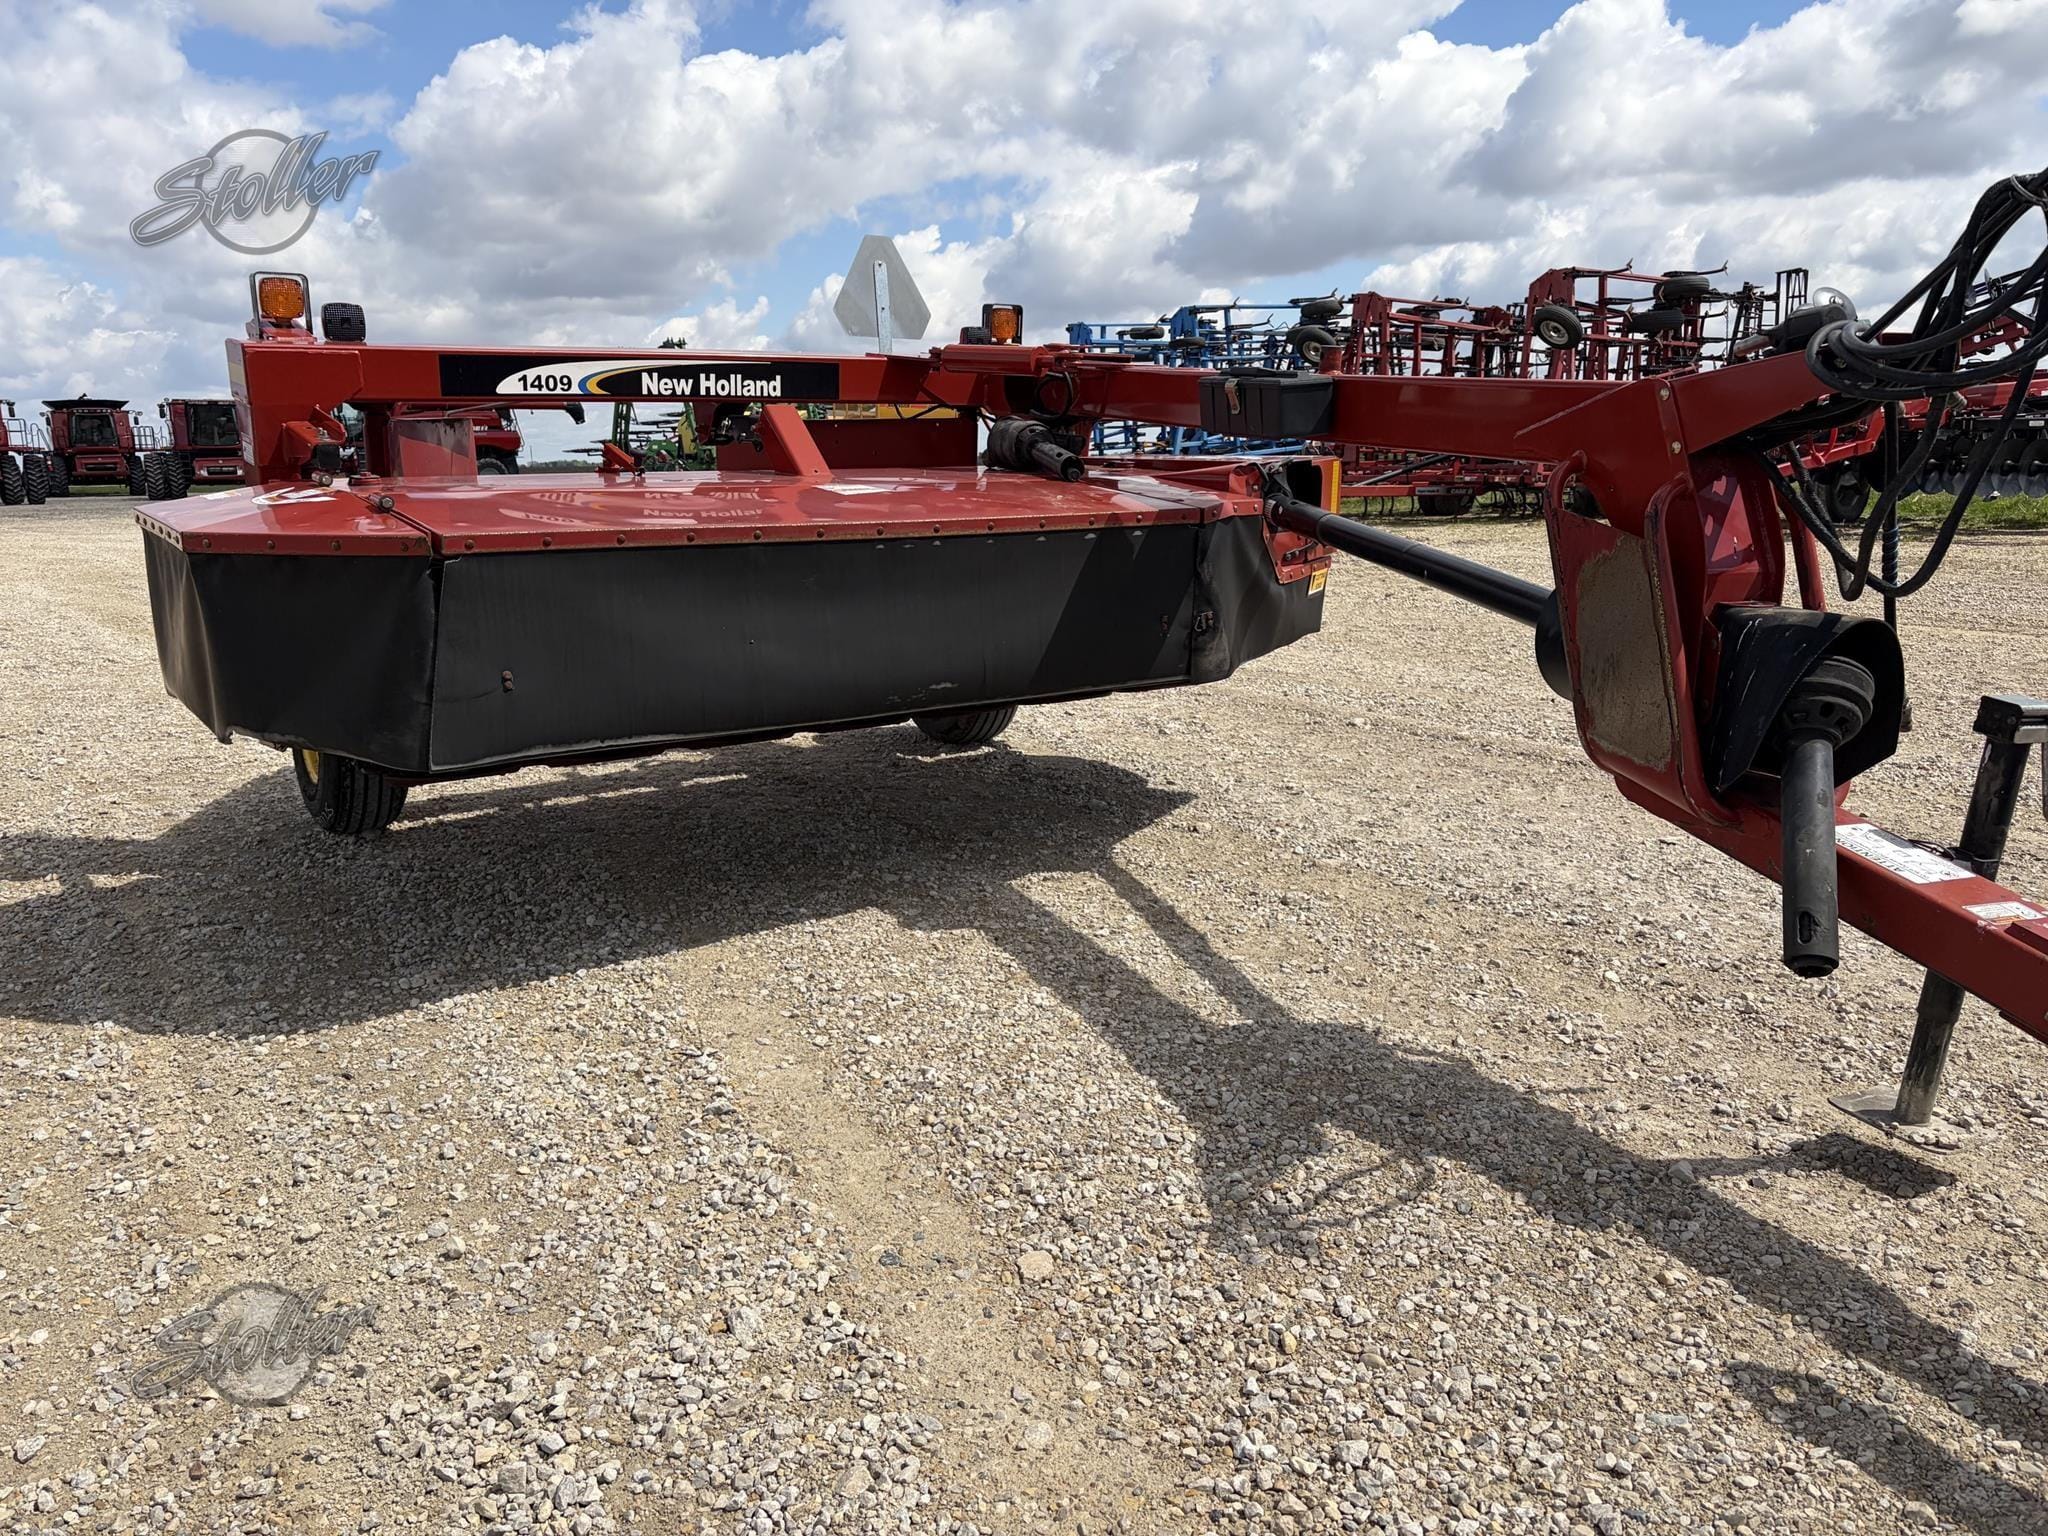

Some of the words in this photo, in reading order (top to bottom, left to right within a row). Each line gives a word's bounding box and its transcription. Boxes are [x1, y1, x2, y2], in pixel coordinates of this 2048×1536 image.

[518, 374, 572, 392] 1409
[641, 372, 693, 395] New
[700, 373, 782, 397] Holland
